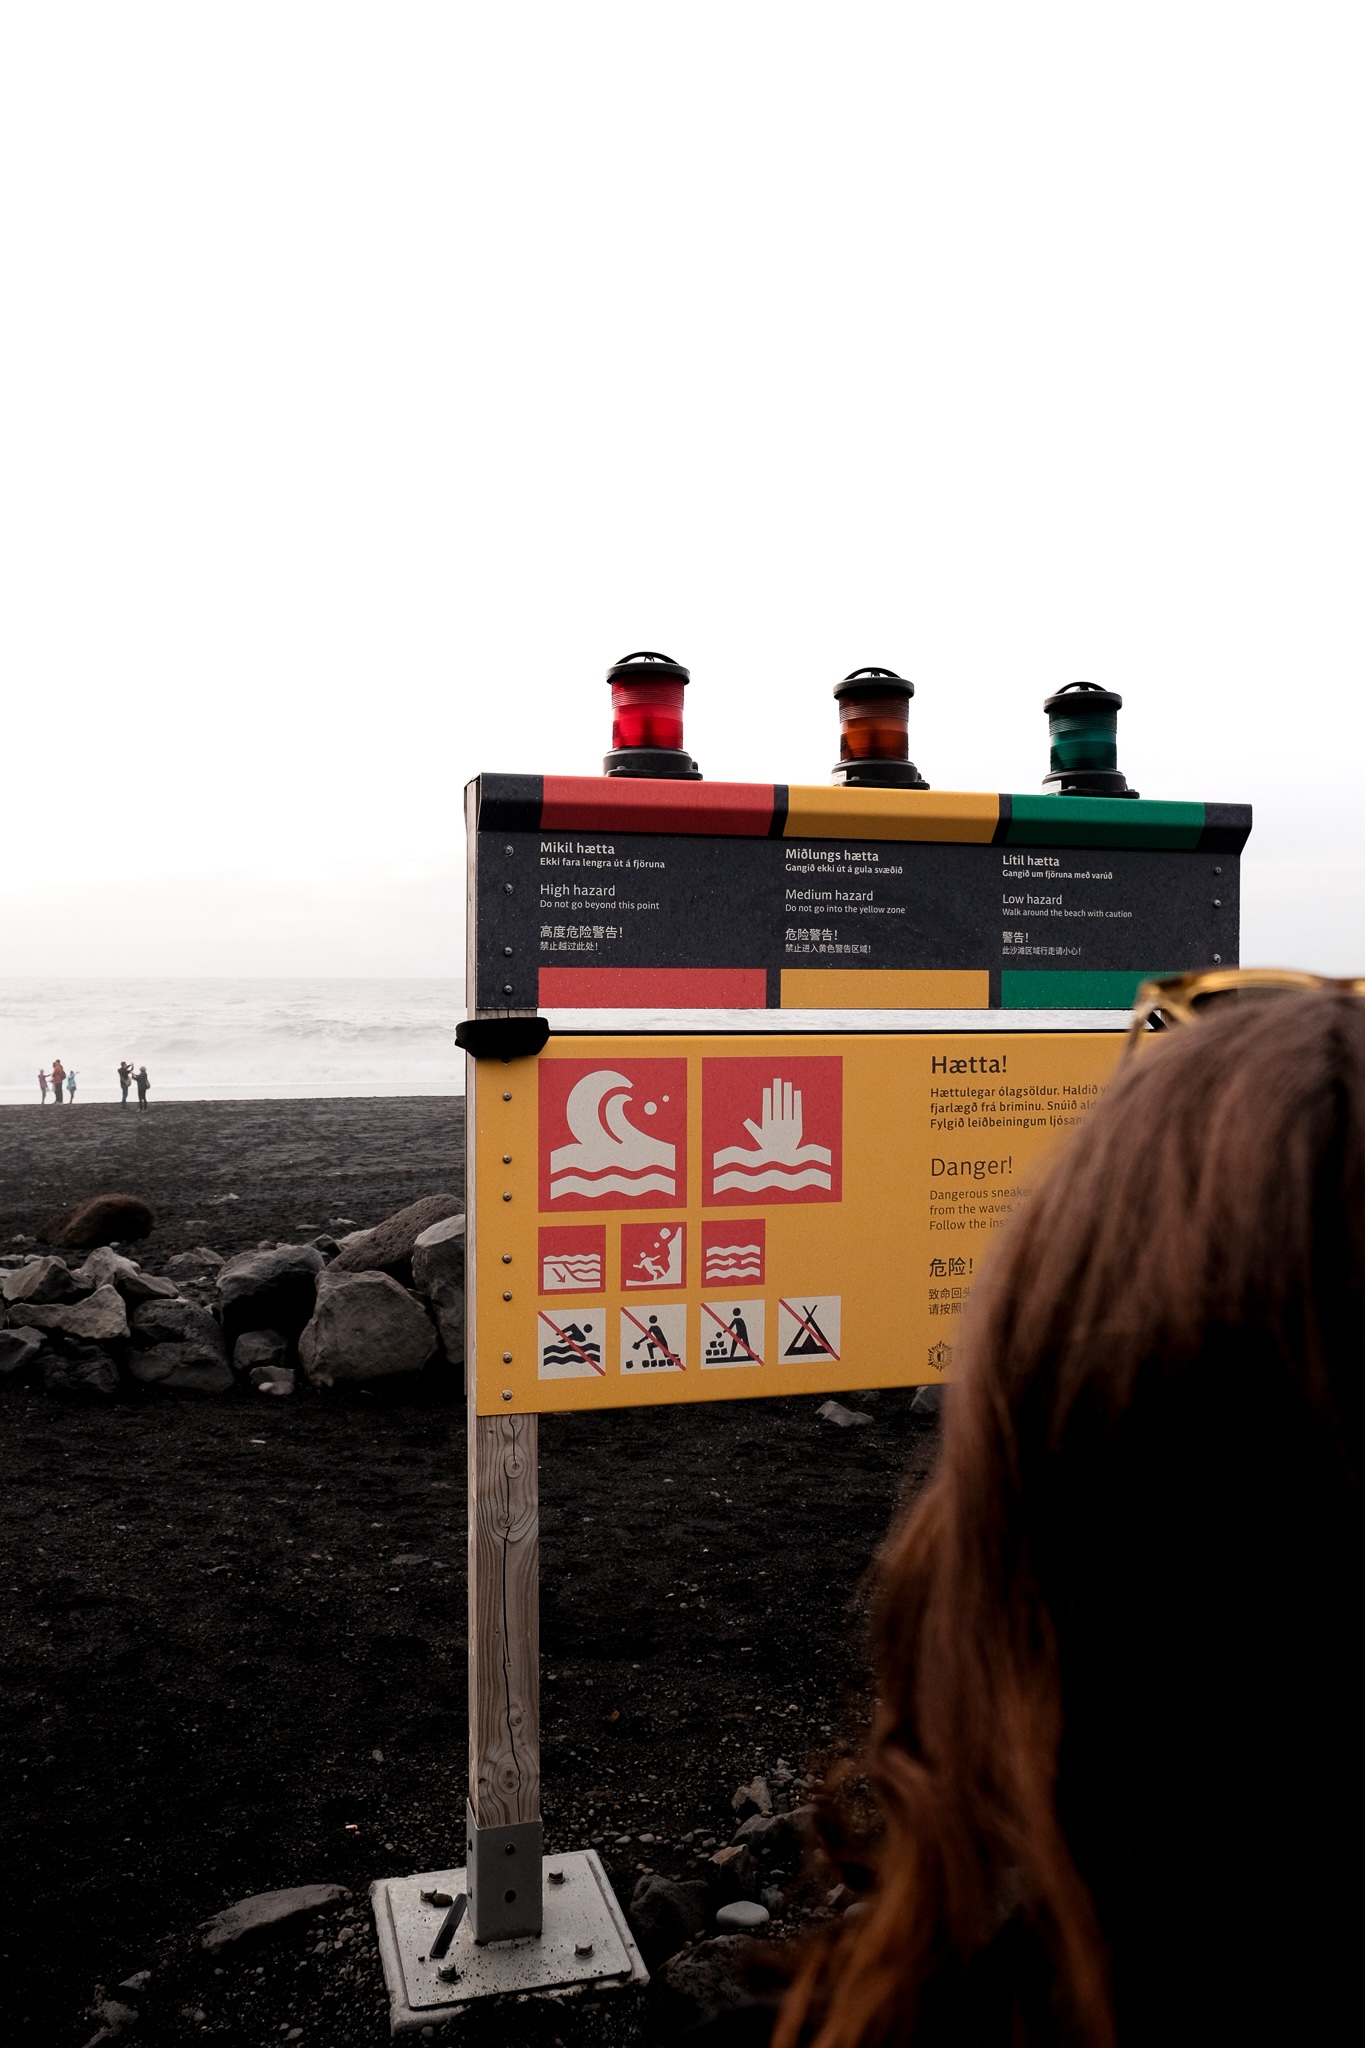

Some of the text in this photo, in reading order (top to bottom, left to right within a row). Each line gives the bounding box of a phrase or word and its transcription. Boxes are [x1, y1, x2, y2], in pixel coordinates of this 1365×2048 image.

[540, 842, 615, 854] Mikil hætta
[786, 849, 879, 862] Miðlungs hætta
[1003, 855, 1060, 866] Lítil hætta
[540, 858, 560, 866] Ekki
[562, 858, 580, 866] fara
[583, 859, 611, 868] lengra
[614, 859, 623, 867] út
[633, 860, 665, 869] fjöruna
[785, 864, 815, 873] Gangið
[817, 864, 834, 872] ekki
[848, 865, 852, 873] á
[854, 866, 872, 874] gula
[875, 866, 902, 874] svæðið
[1002, 870, 1030, 878] Gangið
[1045, 870, 1072, 879] fjöruna
[540, 884, 616, 897] High hazard
[786, 889, 873, 901] Medium hazard
[1003, 894, 1062, 904] Low hazard
[540, 900, 660, 911] Do not go beyond this point
[786, 904, 796, 912] Do
[814, 906, 824, 914] go
[860, 906, 885, 914] yellow
[1023, 908, 1048, 916] around
[932, 1055, 1007, 1074] Hætta!
[930, 1088, 996, 1099] Hættulegar
[998, 1086, 1059, 1098] ólagsöldur.
[1063, 1085, 1098, 1095] Haldið
[930, 1102, 978, 1115] fjarlægð
[981, 1101, 996, 1112] frá
[1000, 1101, 1044, 1112] briminu.
[1047, 1100, 1077, 1110] Snúið
[930, 1118, 965, 1130] Fylgið
[968, 1117, 1046, 1128] leiðbeiningum
[932, 1156, 1012, 1180] Danger!
[930, 1190, 988, 1201] Dangerous
[992, 1187, 1033, 1197] sneaker
[930, 1205, 955, 1215] from
[958, 1204, 976, 1214] the
[930, 1220, 966, 1230] Follow
[969, 1219, 986, 1229] the
[929, 1257, 973, 1278] 危险!
